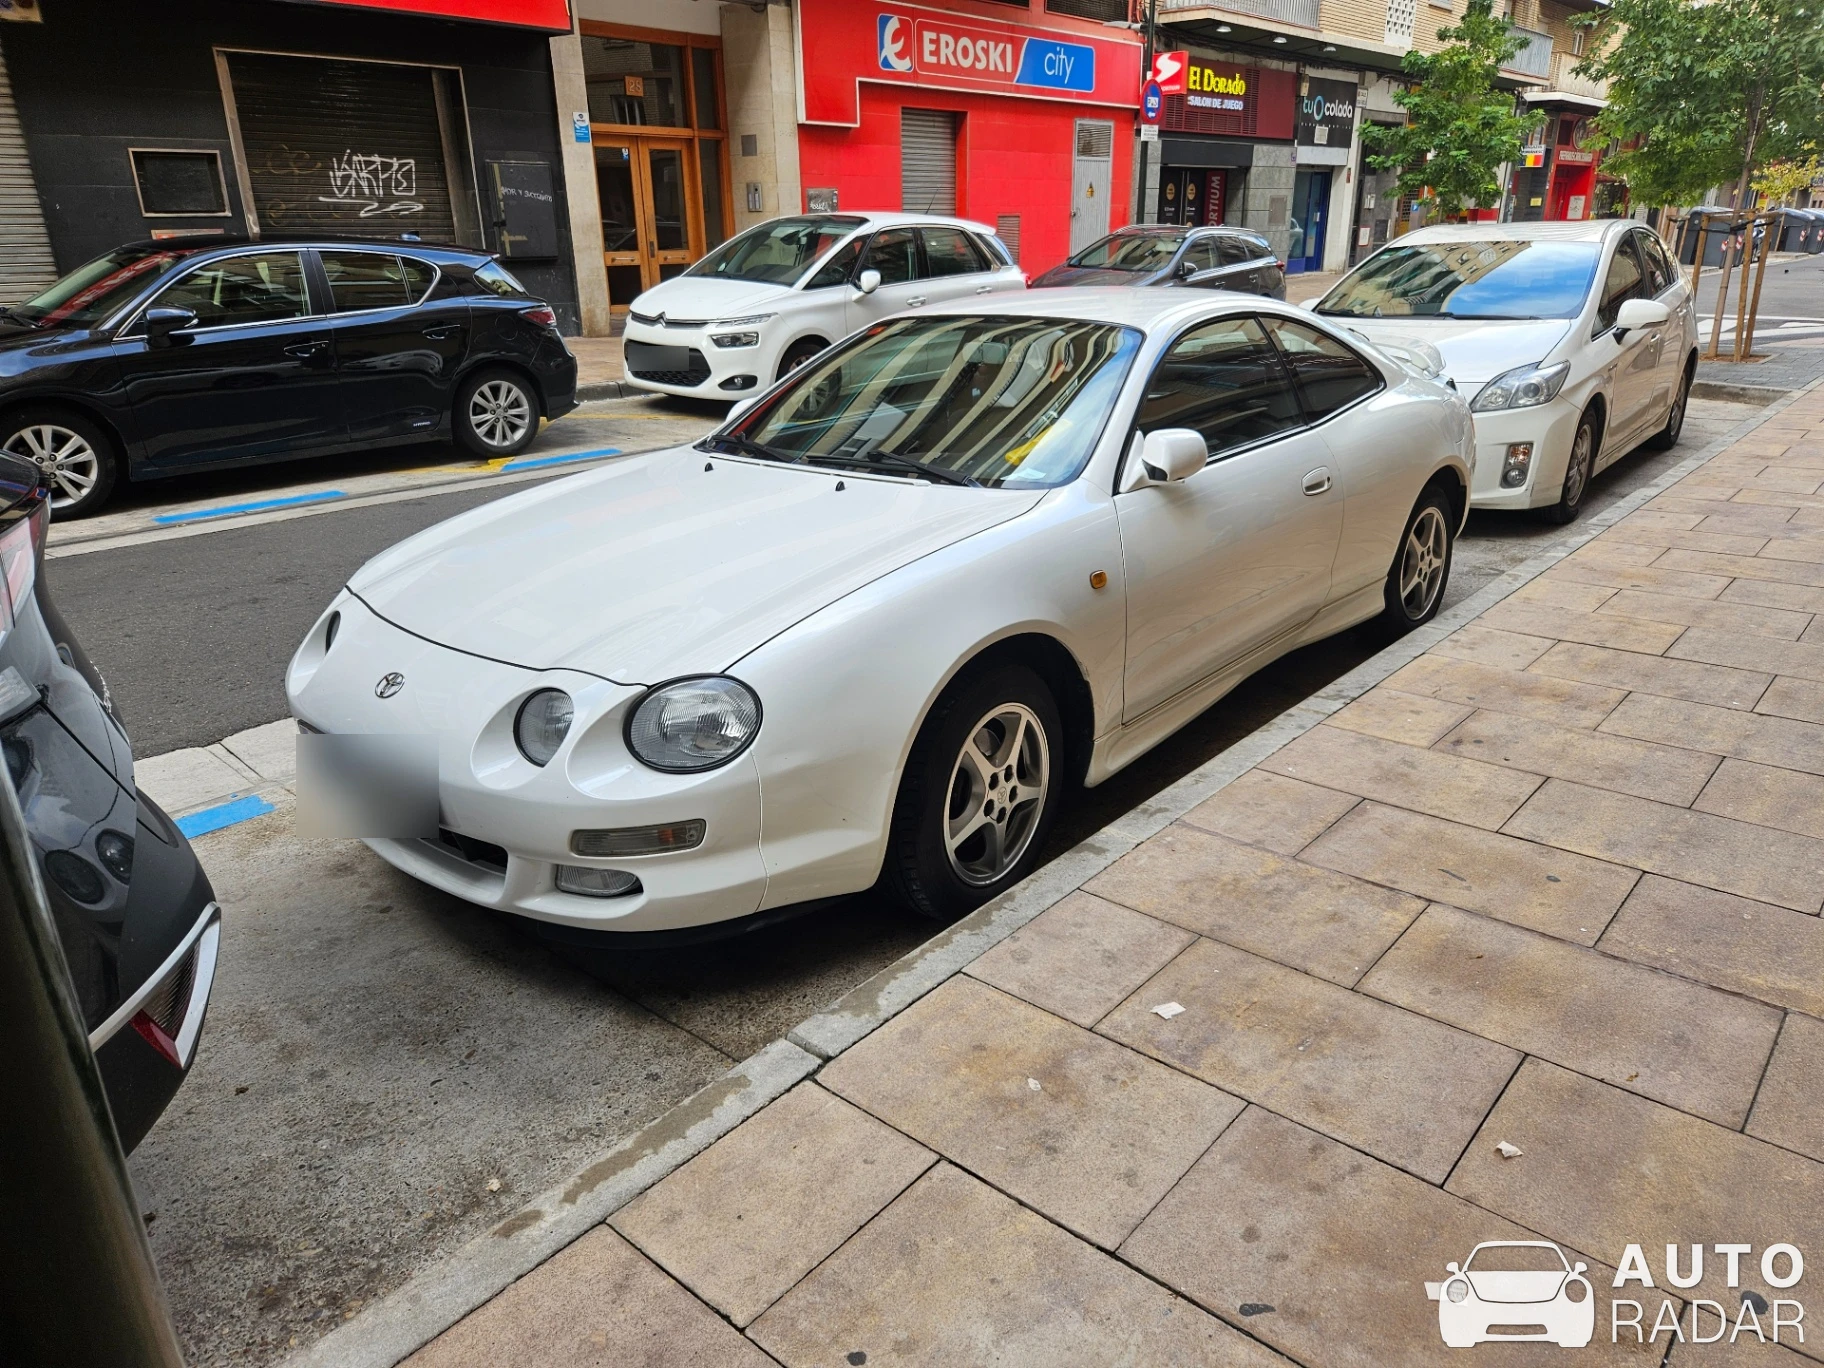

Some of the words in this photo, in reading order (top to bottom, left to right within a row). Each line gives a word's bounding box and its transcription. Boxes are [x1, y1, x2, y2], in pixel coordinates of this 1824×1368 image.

[922, 30, 1013, 73] EROSKI
[1044, 46, 1075, 84] city
[1212, 98, 1222, 108] DE
[1222, 99, 1244, 110] JUEGO
[1324, 99, 1353, 118] colada
